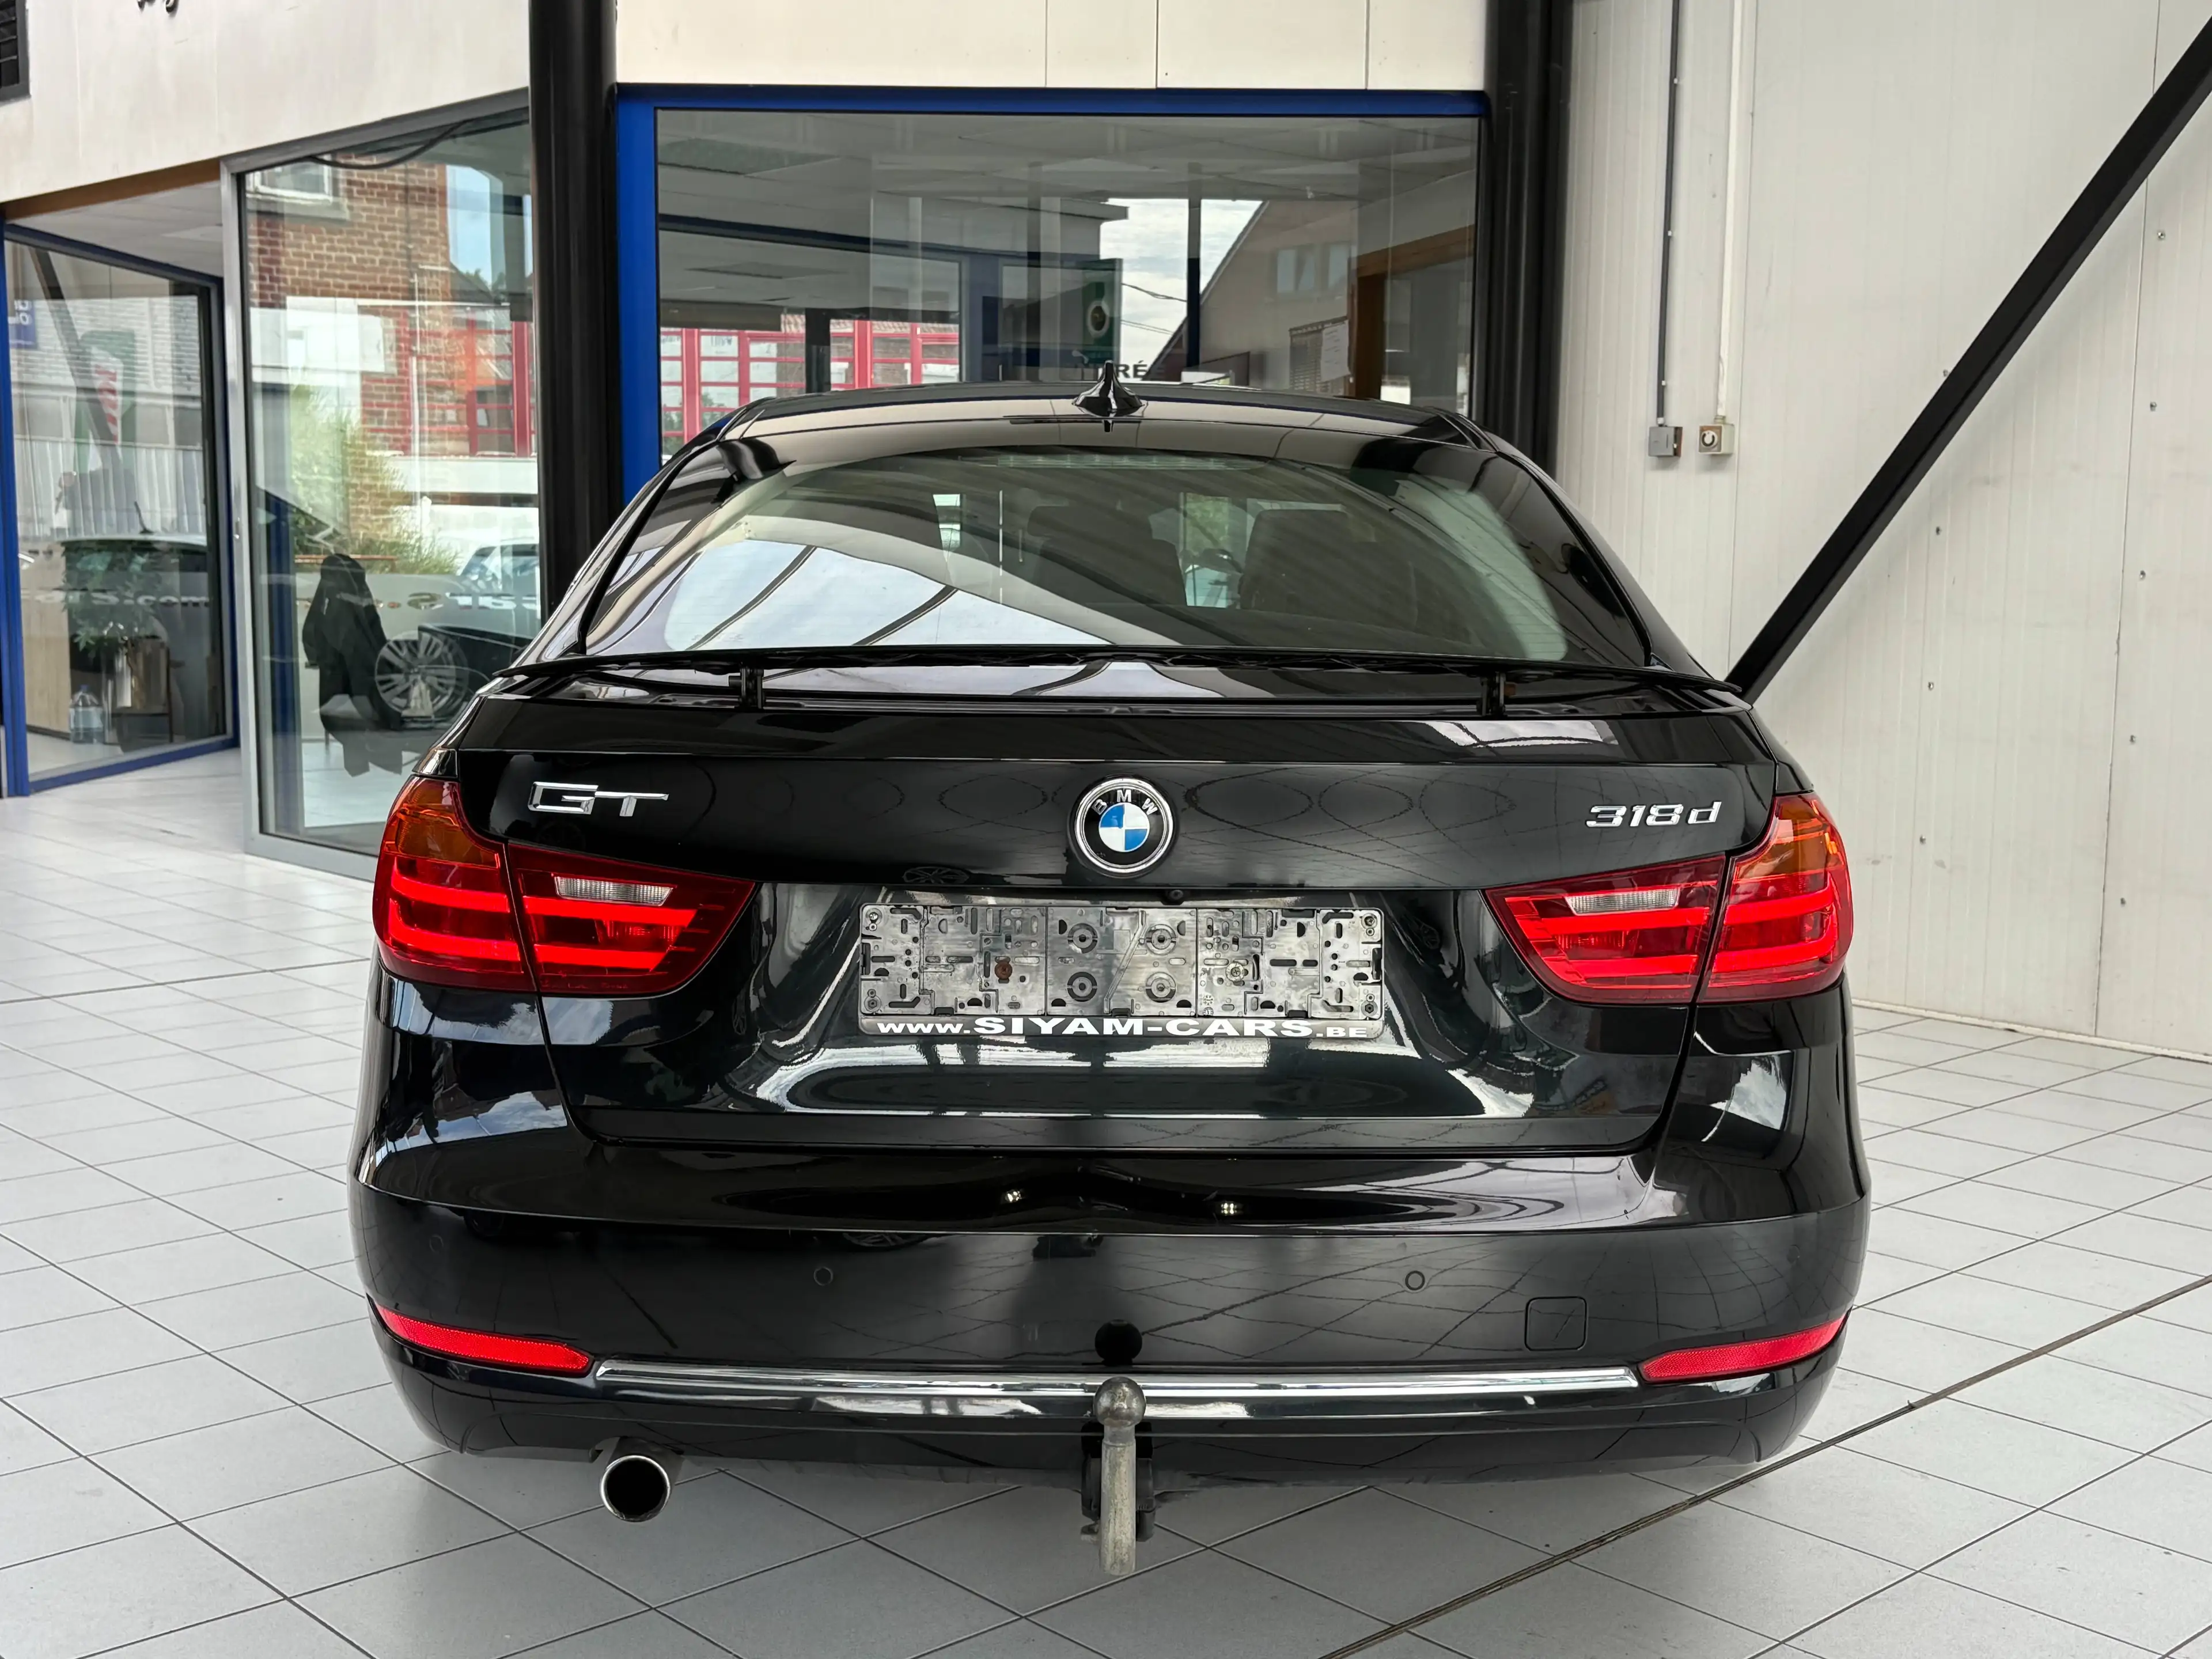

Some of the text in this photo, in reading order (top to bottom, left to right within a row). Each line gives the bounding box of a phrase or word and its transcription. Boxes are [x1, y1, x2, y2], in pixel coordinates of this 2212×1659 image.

[527, 781, 670, 817] GT
[1092, 789, 1158, 816] BMW
[1586, 801, 1722, 827] 318d
[876, 1017, 1368, 1037] www.SIYAM-CARS.BE
